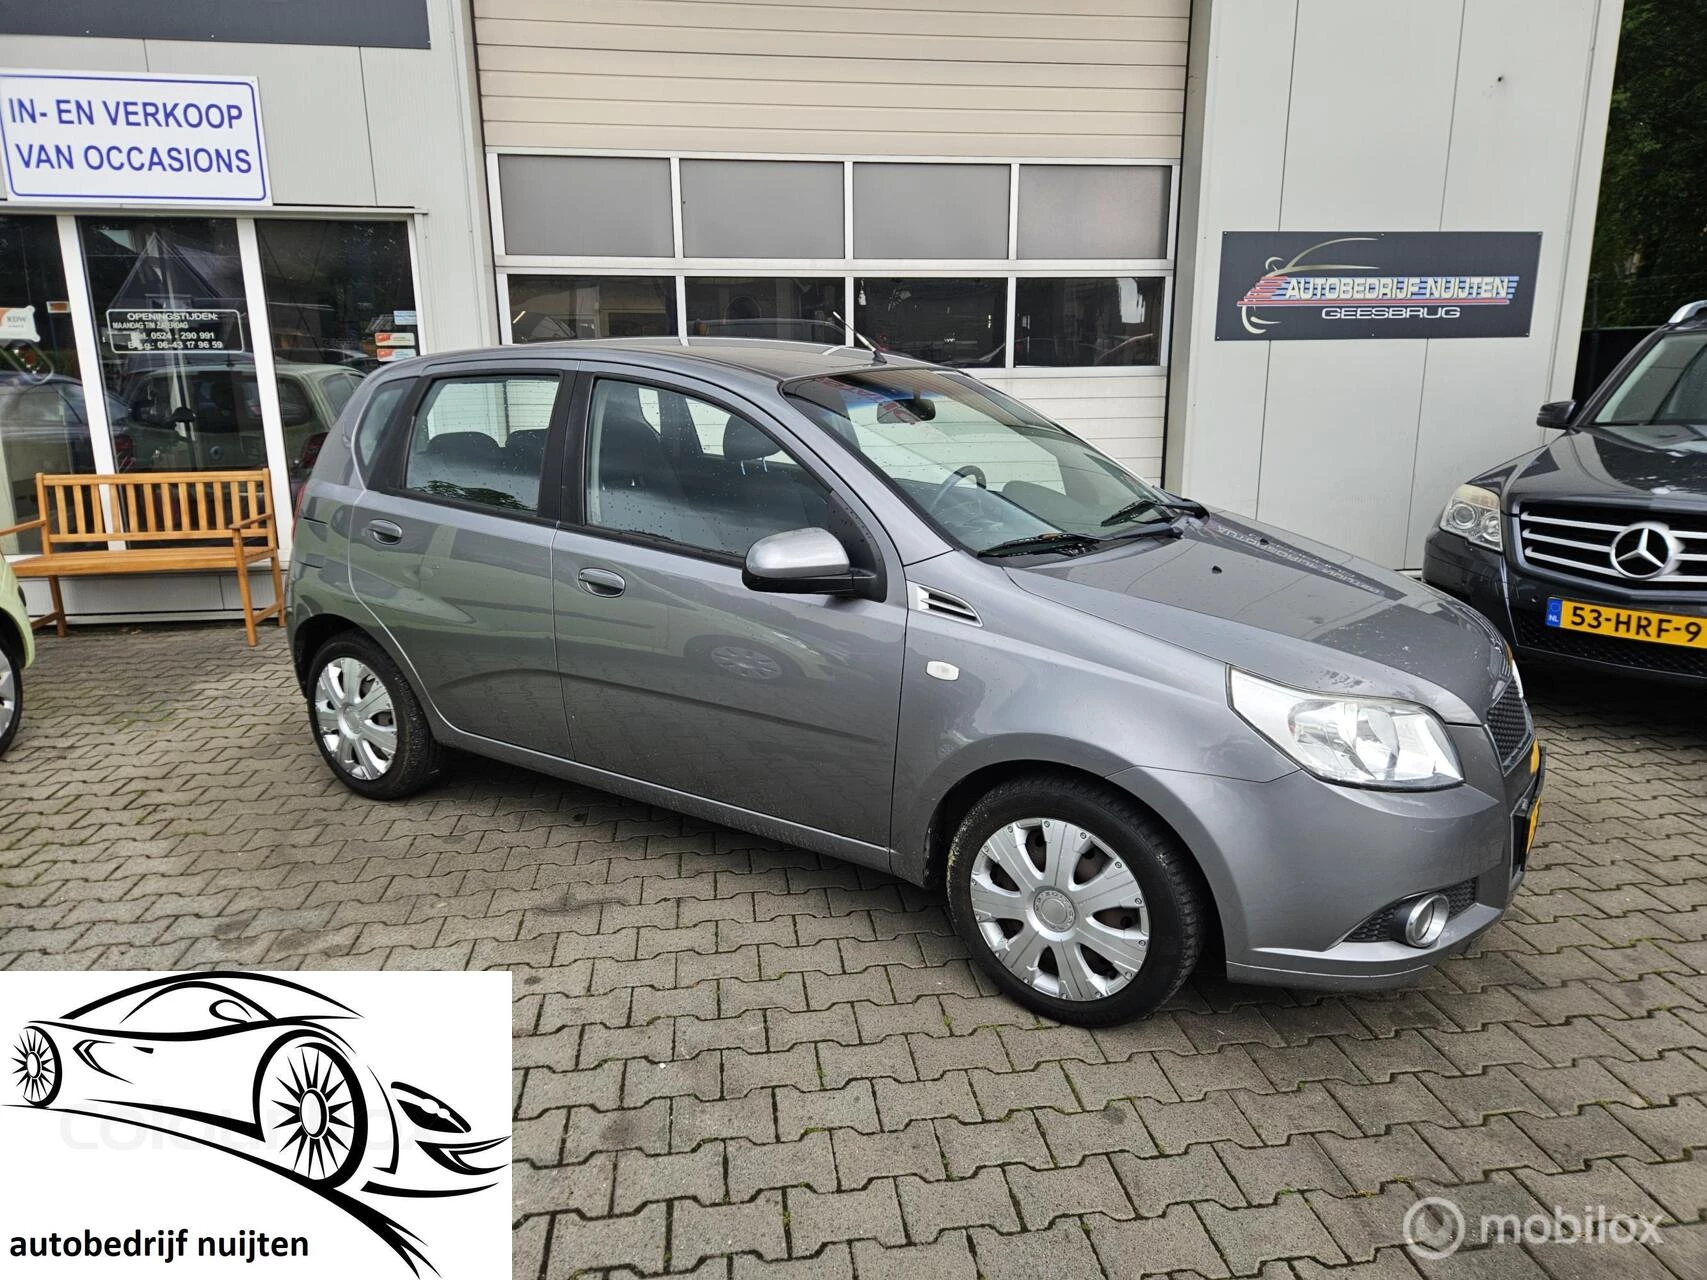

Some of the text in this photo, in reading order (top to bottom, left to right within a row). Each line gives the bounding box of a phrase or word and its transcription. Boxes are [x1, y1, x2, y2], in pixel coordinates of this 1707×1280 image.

[8, 98, 243, 129] IN- EN VERKOOP
[14, 143, 252, 174] VAN OCCASIONS
[1285, 276, 1508, 299] AUTOBEDRIJF NUIJTEN
[127, 312, 219, 321] OPENINGSTIJDEN:
[1321, 307, 1461, 319] GEESBRUG
[112, 321, 145, 329] MAANDAG
[150, 331, 172, 340] 0524
[180, 331, 198, 340] 290
[199, 331, 215, 340] 991
[186, 341, 196, 349] 17
[197, 341, 210, 349] 96
[211, 341, 224, 349] 59
[1548, 614, 1559, 623] NL
[1571, 606, 1702, 642] 53-HRF-9
